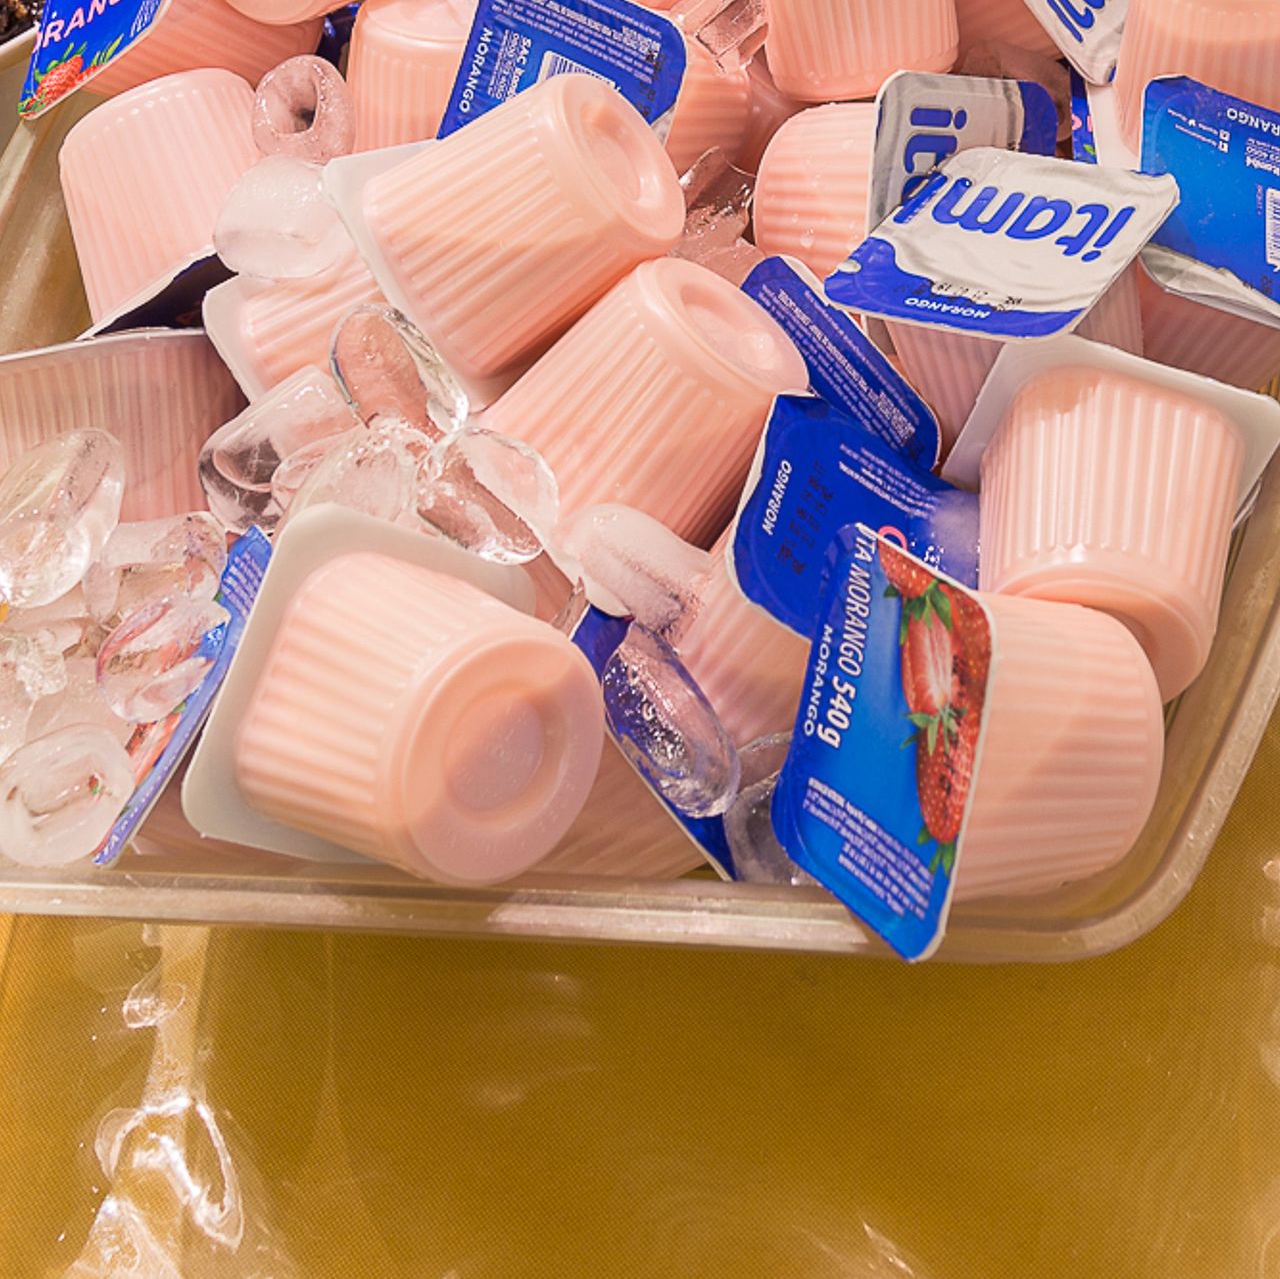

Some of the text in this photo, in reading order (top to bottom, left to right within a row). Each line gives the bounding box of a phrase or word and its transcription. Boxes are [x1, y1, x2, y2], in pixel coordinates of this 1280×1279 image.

[459, 28, 492, 112] MORANGO
[515, 38, 531, 65] SAC
[903, 296, 989, 319] MORANGO
[763, 461, 791, 535] MORANGO
[839, 564, 869, 675] MORANGO
[802, 625, 832, 736] MORANGO
